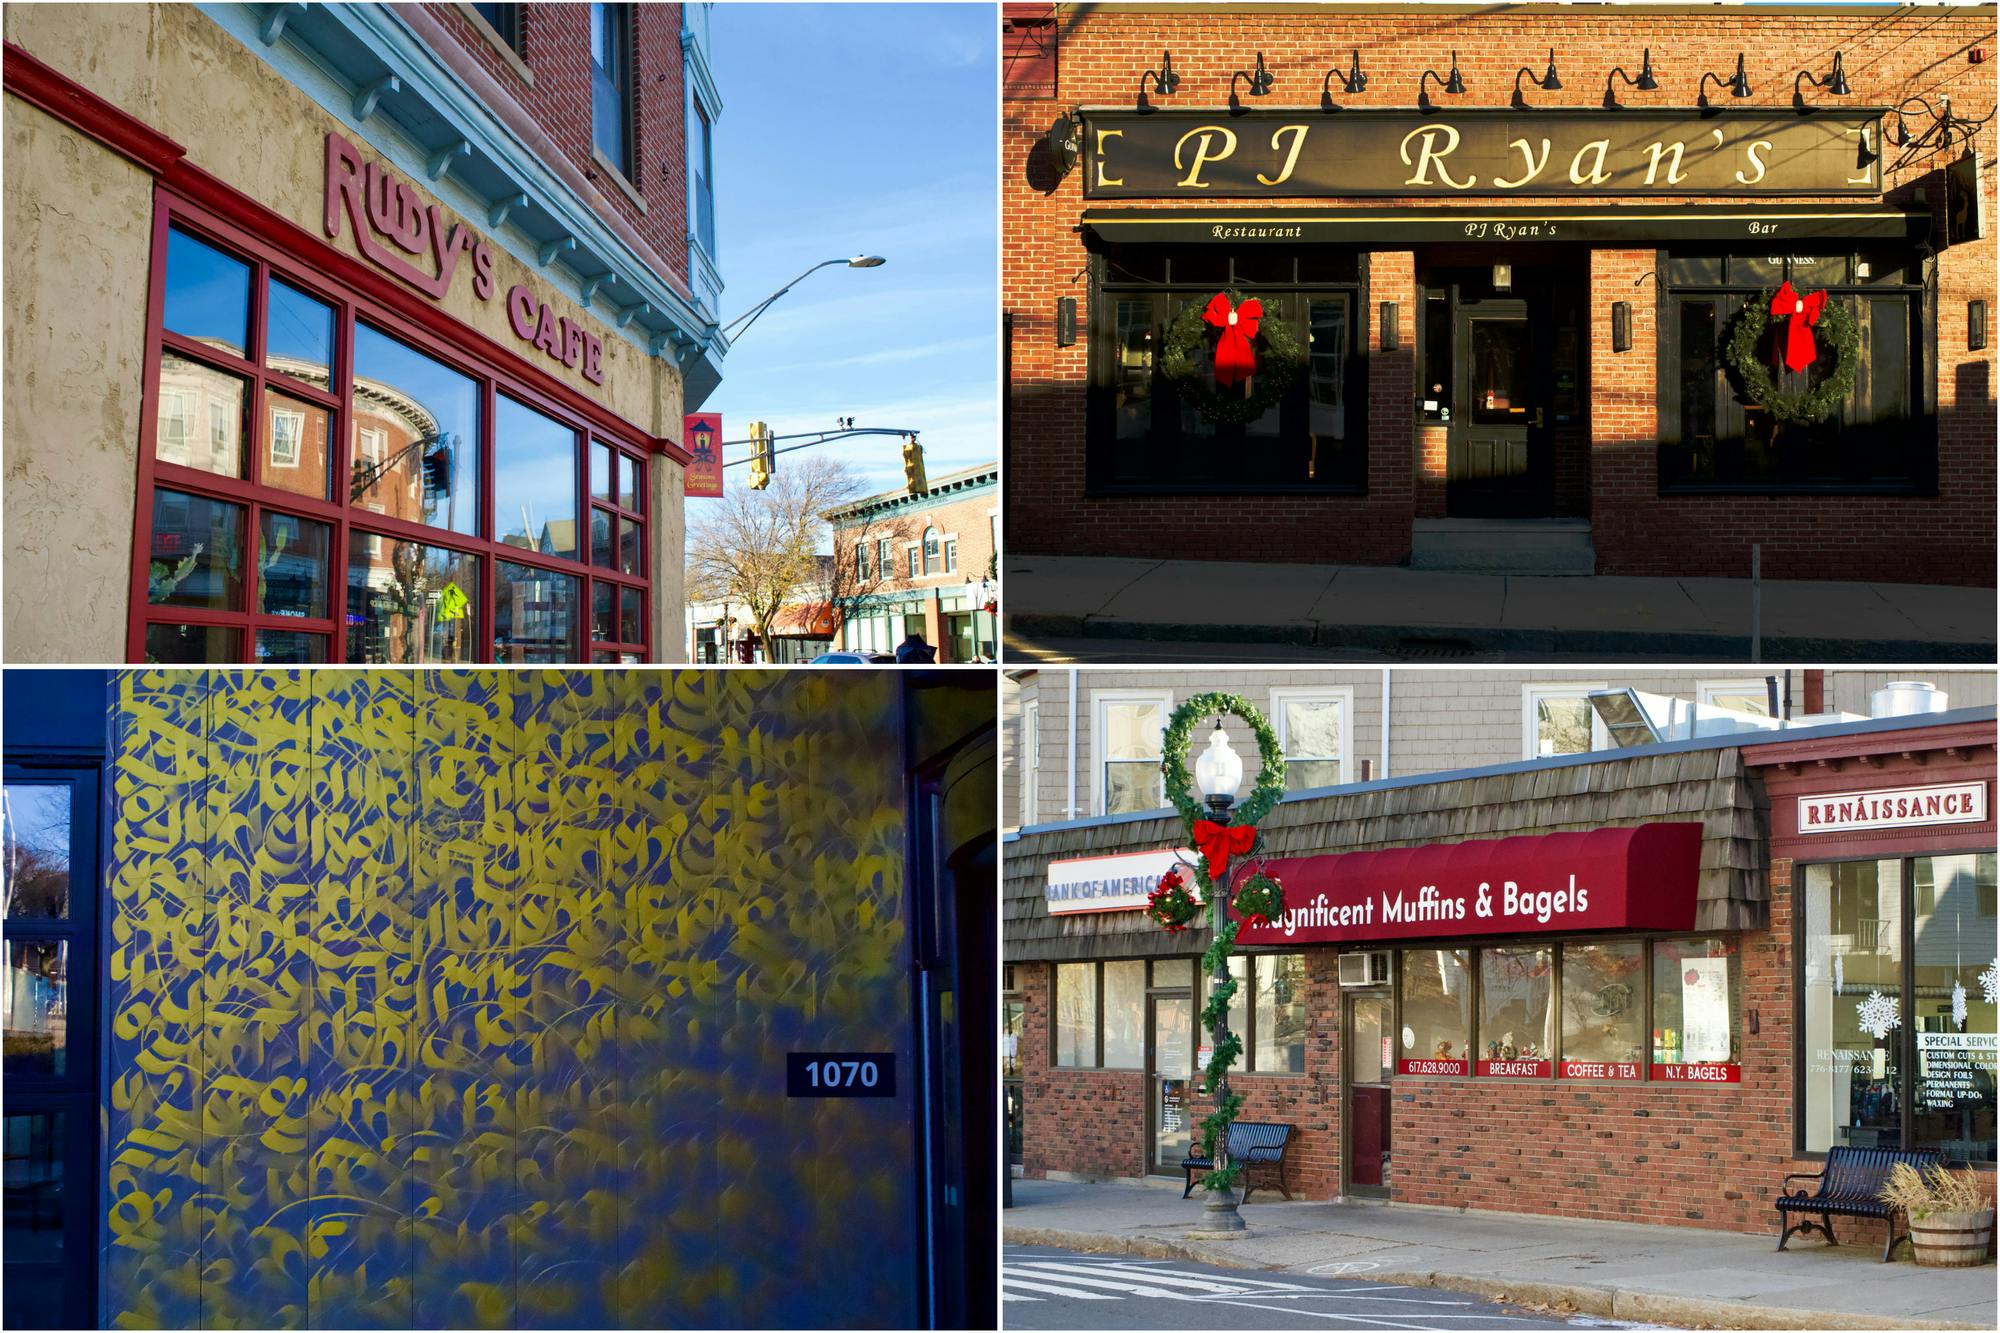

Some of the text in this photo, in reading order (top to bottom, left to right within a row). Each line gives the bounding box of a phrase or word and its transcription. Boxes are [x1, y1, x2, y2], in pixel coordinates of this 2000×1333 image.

[1174, 124, 1774, 189] PJ Ryan's
[1212, 224, 1302, 240] Restaurant
[1464, 220, 1557, 241] PJ Ryan's
[1748, 222, 1779, 235] Bar
[324, 131, 605, 386] RUDY'S CAFE
[1807, 793, 1974, 825] RENÁISSANCE
[1044, 882, 1079, 901] BANK
[1081, 880, 1099, 899] OF
[1382, 885, 1466, 924] Muffins
[1475, 881, 1494, 919] &
[1503, 873, 1588, 924] Bagels
[1924, 1036, 1962, 1047] SPECIAL
[1816, 1049, 1890, 1061] RENAISSANE
[1926, 1052, 1955, 1060] CUSTOM
[1957, 1052, 1976, 1060] CUTS
[1978, 1052, 1984, 1060] &
[1408, 1061, 1460, 1075] 617.628.9000
[1489, 1062, 1538, 1076] BREAKFAST
[1567, 1064, 1636, 1078] COFFEE & TEA
[1926, 1061, 1972, 1070] DIMENSIONAL
[805, 1061, 878, 1087] 1070
[1665, 1066, 1728, 1080] N.Y. BAGELS
[1926, 1071, 1973, 1079] DESIGN FOILS
[1926, 1081, 1970, 1089] PERMANENTS
[1926, 1089, 1954, 1098] FORMAL
[1926, 1099, 1954, 1108] WAXING
